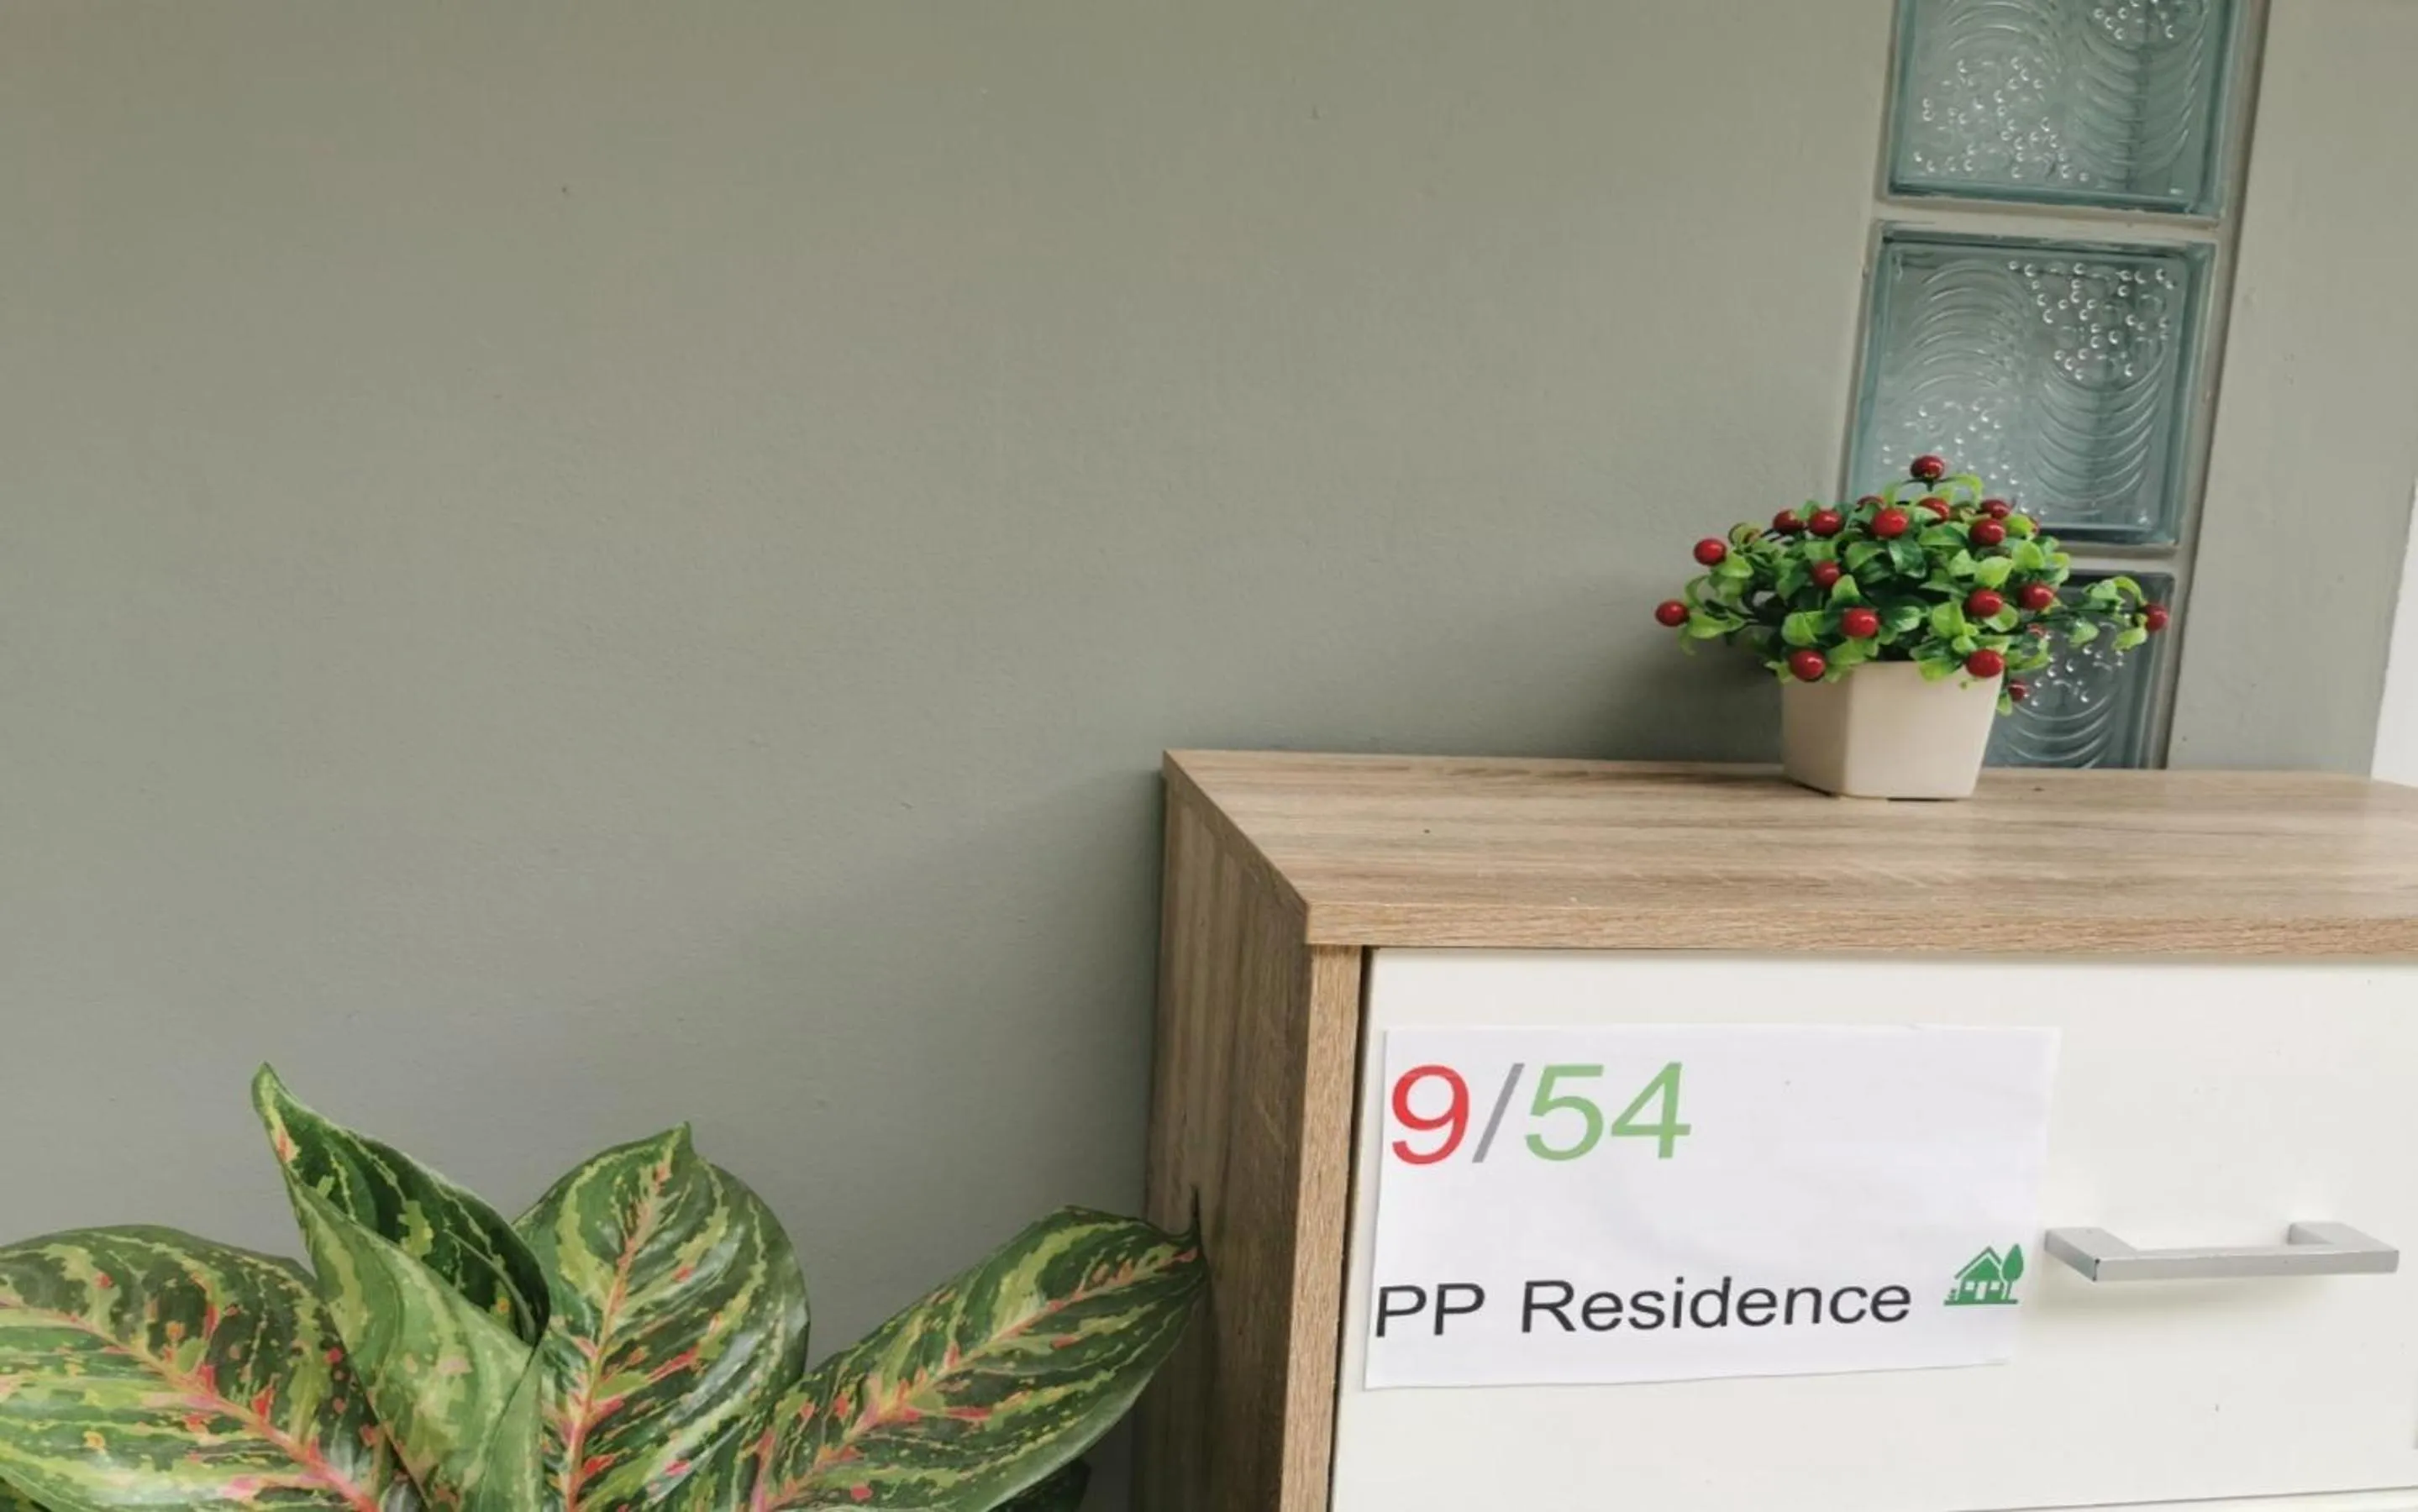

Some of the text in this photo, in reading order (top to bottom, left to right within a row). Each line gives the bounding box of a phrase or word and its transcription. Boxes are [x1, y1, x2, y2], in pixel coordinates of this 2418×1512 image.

[1390, 1062, 1691, 1165] 9/54
[1375, 1276, 1911, 1338] PP Residence
